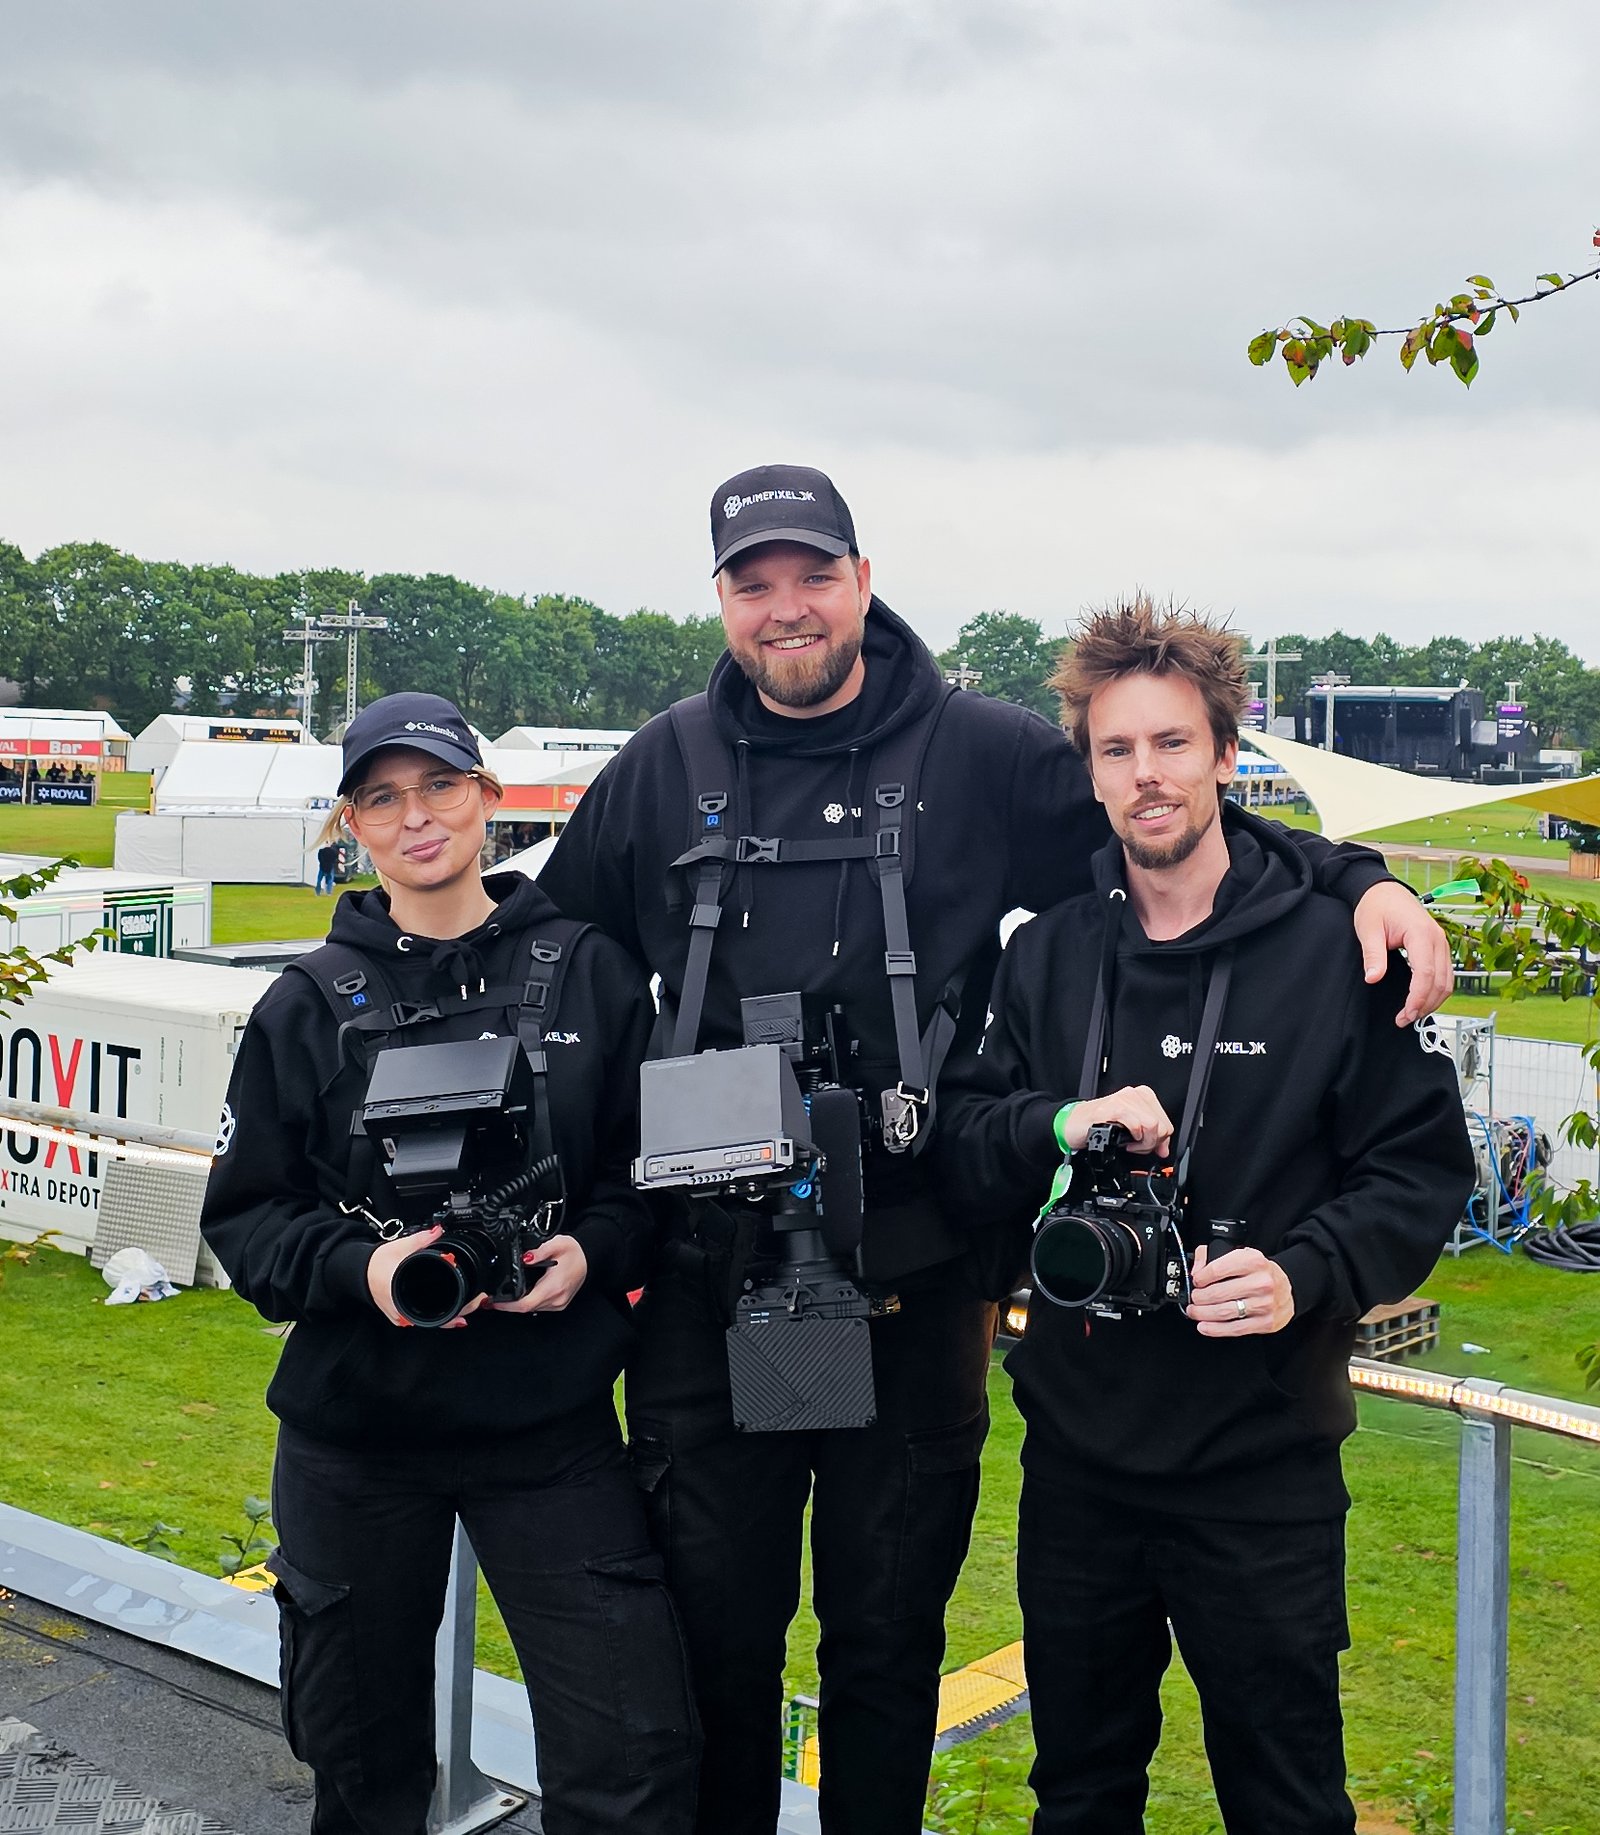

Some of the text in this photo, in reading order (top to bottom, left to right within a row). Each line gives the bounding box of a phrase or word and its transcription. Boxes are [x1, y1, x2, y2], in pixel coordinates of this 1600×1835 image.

[416, 722, 459, 741] Columbia
[49, 740, 82, 754] Bar
[0, 787, 21, 798] OYA
[50, 788, 88, 800] ROYAL
[0, 1028, 141, 1178] OXIT
[47, 1179, 101, 1210] DEPOT
